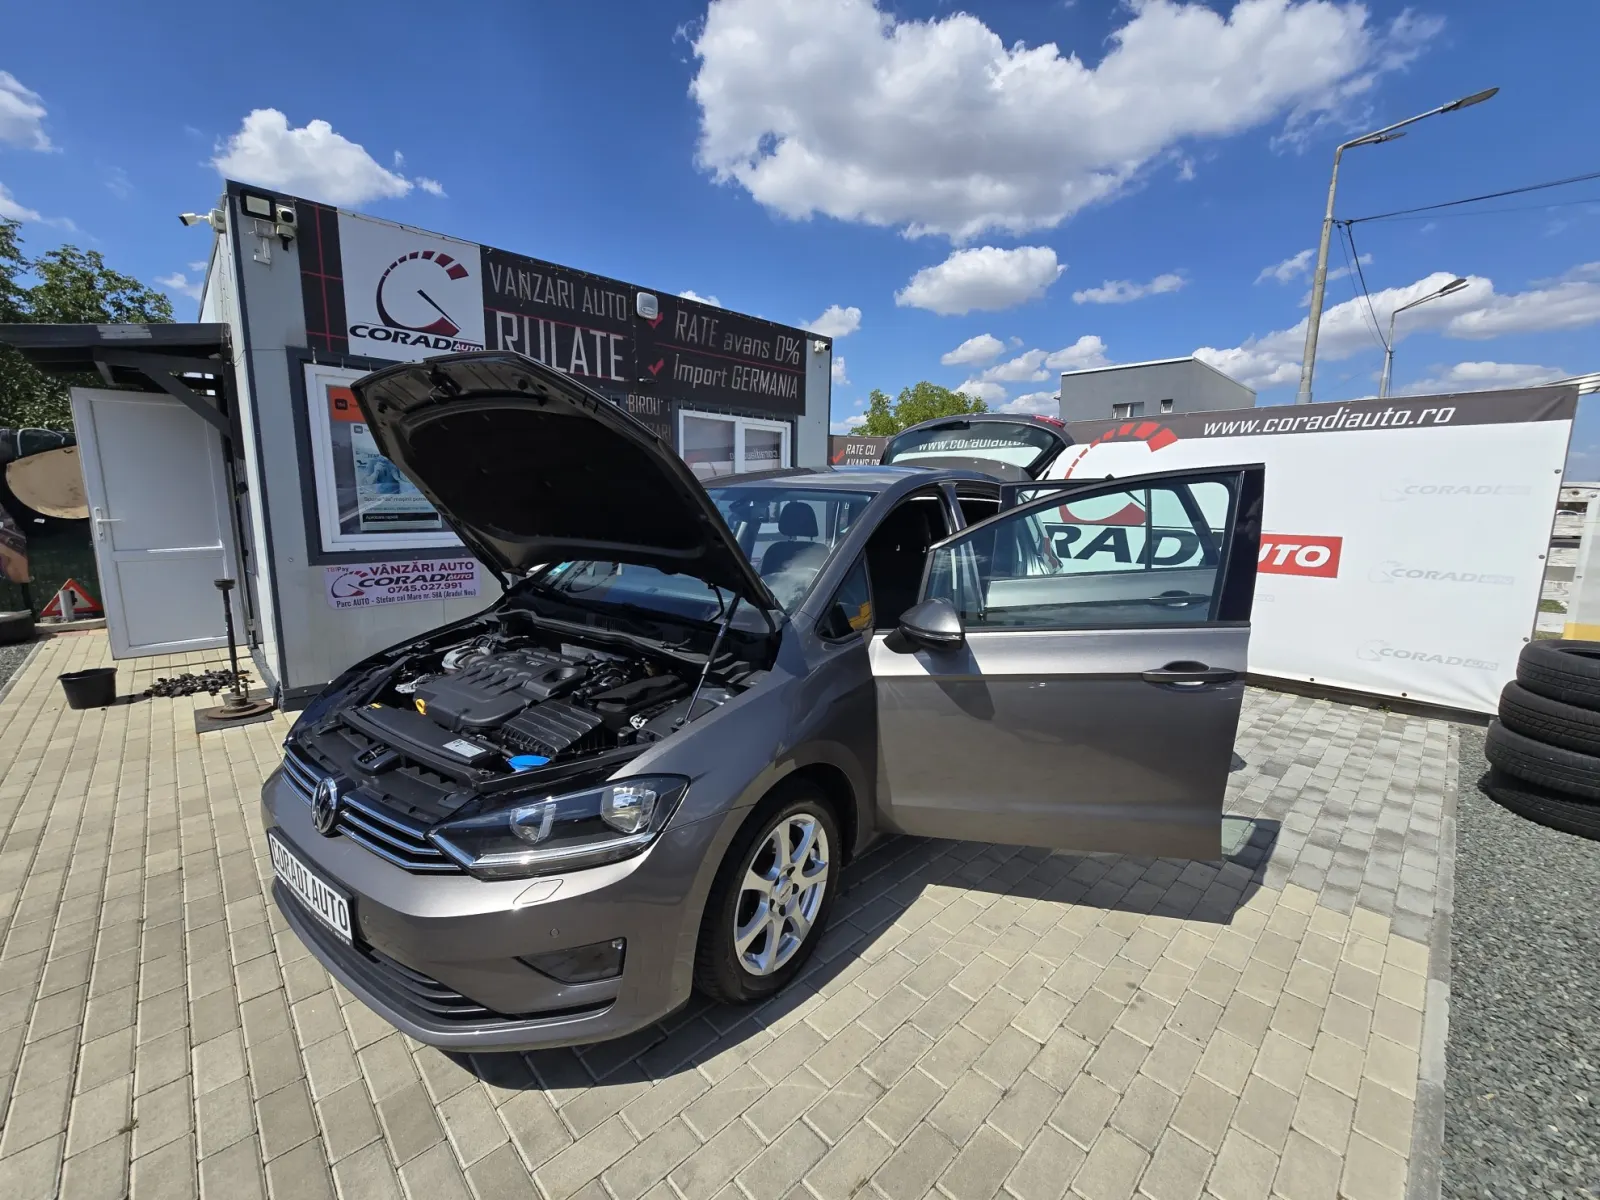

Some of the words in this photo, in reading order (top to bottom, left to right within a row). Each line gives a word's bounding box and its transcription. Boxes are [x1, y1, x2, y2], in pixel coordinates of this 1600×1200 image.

[489, 262, 575, 310] VANZARI
[582, 286, 627, 321] AUTO
[496, 310, 625, 381] RULATE
[674, 310, 719, 347] RATE
[723, 332, 770, 359] avans
[775, 335, 800, 365] 0%
[673, 353, 728, 388] Import
[731, 365, 798, 399] GERMANIA
[628, 394, 661, 415] BIROU
[1203, 406, 1456, 436] www.coradiauto.ro
[846, 444, 864, 455] RATE
[865, 444, 876, 456] CU
[358, 573, 453, 588] CORADI
[369, 561, 435, 576] VÂNZĂRI
[439, 561, 474, 572] AUTO
[388, 582, 462, 594] 0745.027.991
[353, 597, 370, 606] AUTO
[270, 836, 311, 901] CORADI
[311, 876, 348, 932] AUTO
